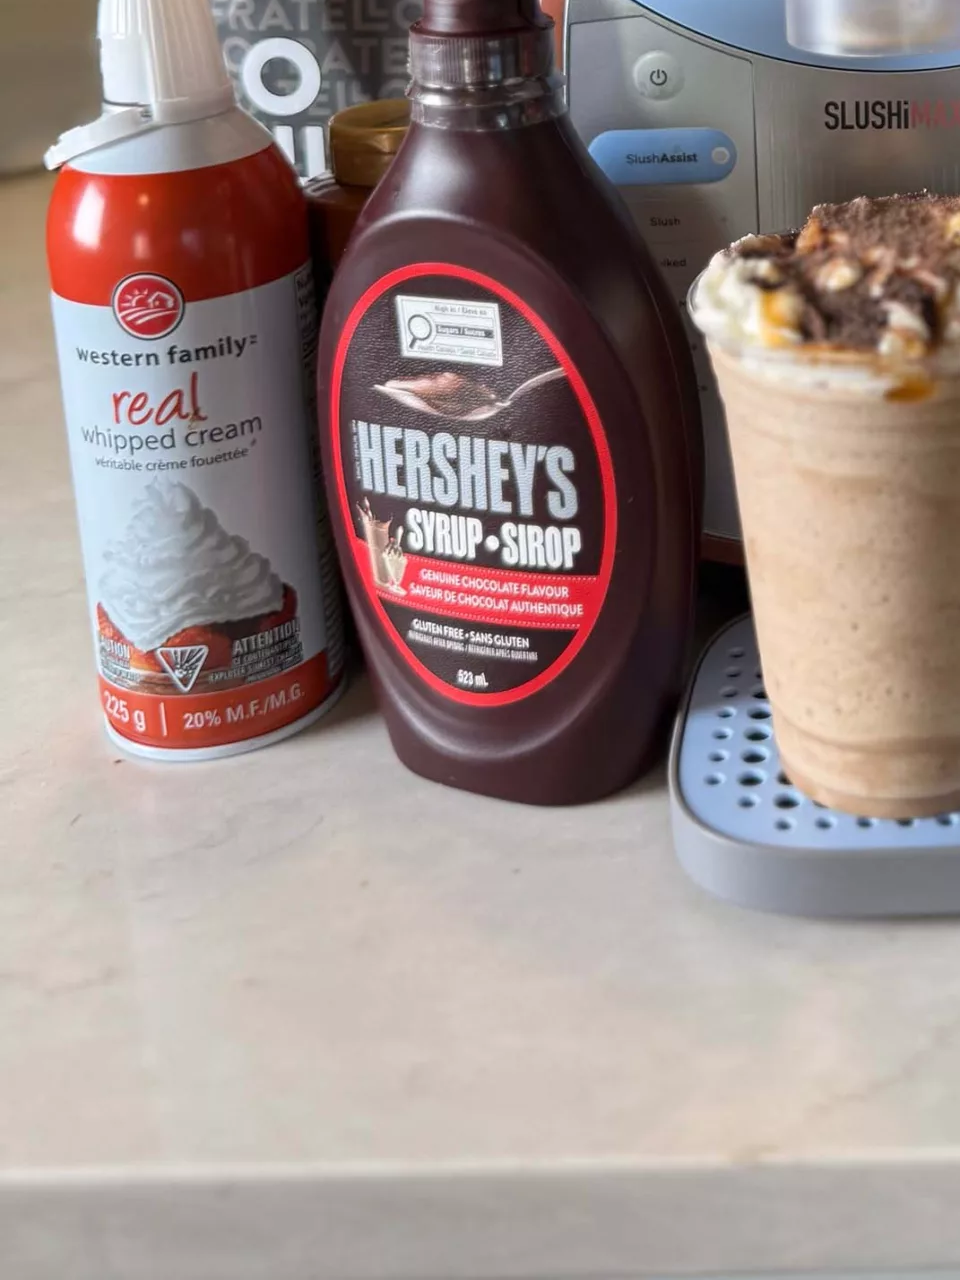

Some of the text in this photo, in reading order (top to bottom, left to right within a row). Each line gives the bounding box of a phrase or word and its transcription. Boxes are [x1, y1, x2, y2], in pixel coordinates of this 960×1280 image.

[626, 151, 698, 165] SlushAssist
[650, 216, 680, 227] Slush
[76, 336, 249, 366] western family
[112, 371, 208, 425] real
[81, 416, 262, 455] whipped cream
[146, 455, 188, 470] crème
[191, 447, 249, 468] fouettée
[356, 420, 579, 519] HERSHEY'S
[406, 507, 582, 569] SYRUP SIROP
[420, 568, 570, 598] GENUINE CHOCOLATE FLAVOUR
[409, 583, 584, 617] SAVEUR DE CHOCOLAT AUTHENTIQUE
[412, 618, 530, 648] GLUTEN FREE SANS GLUTEN
[457, 669, 489, 687] 523 mL
[103, 683, 306, 733] 225 g 20% M.F./M.G.
